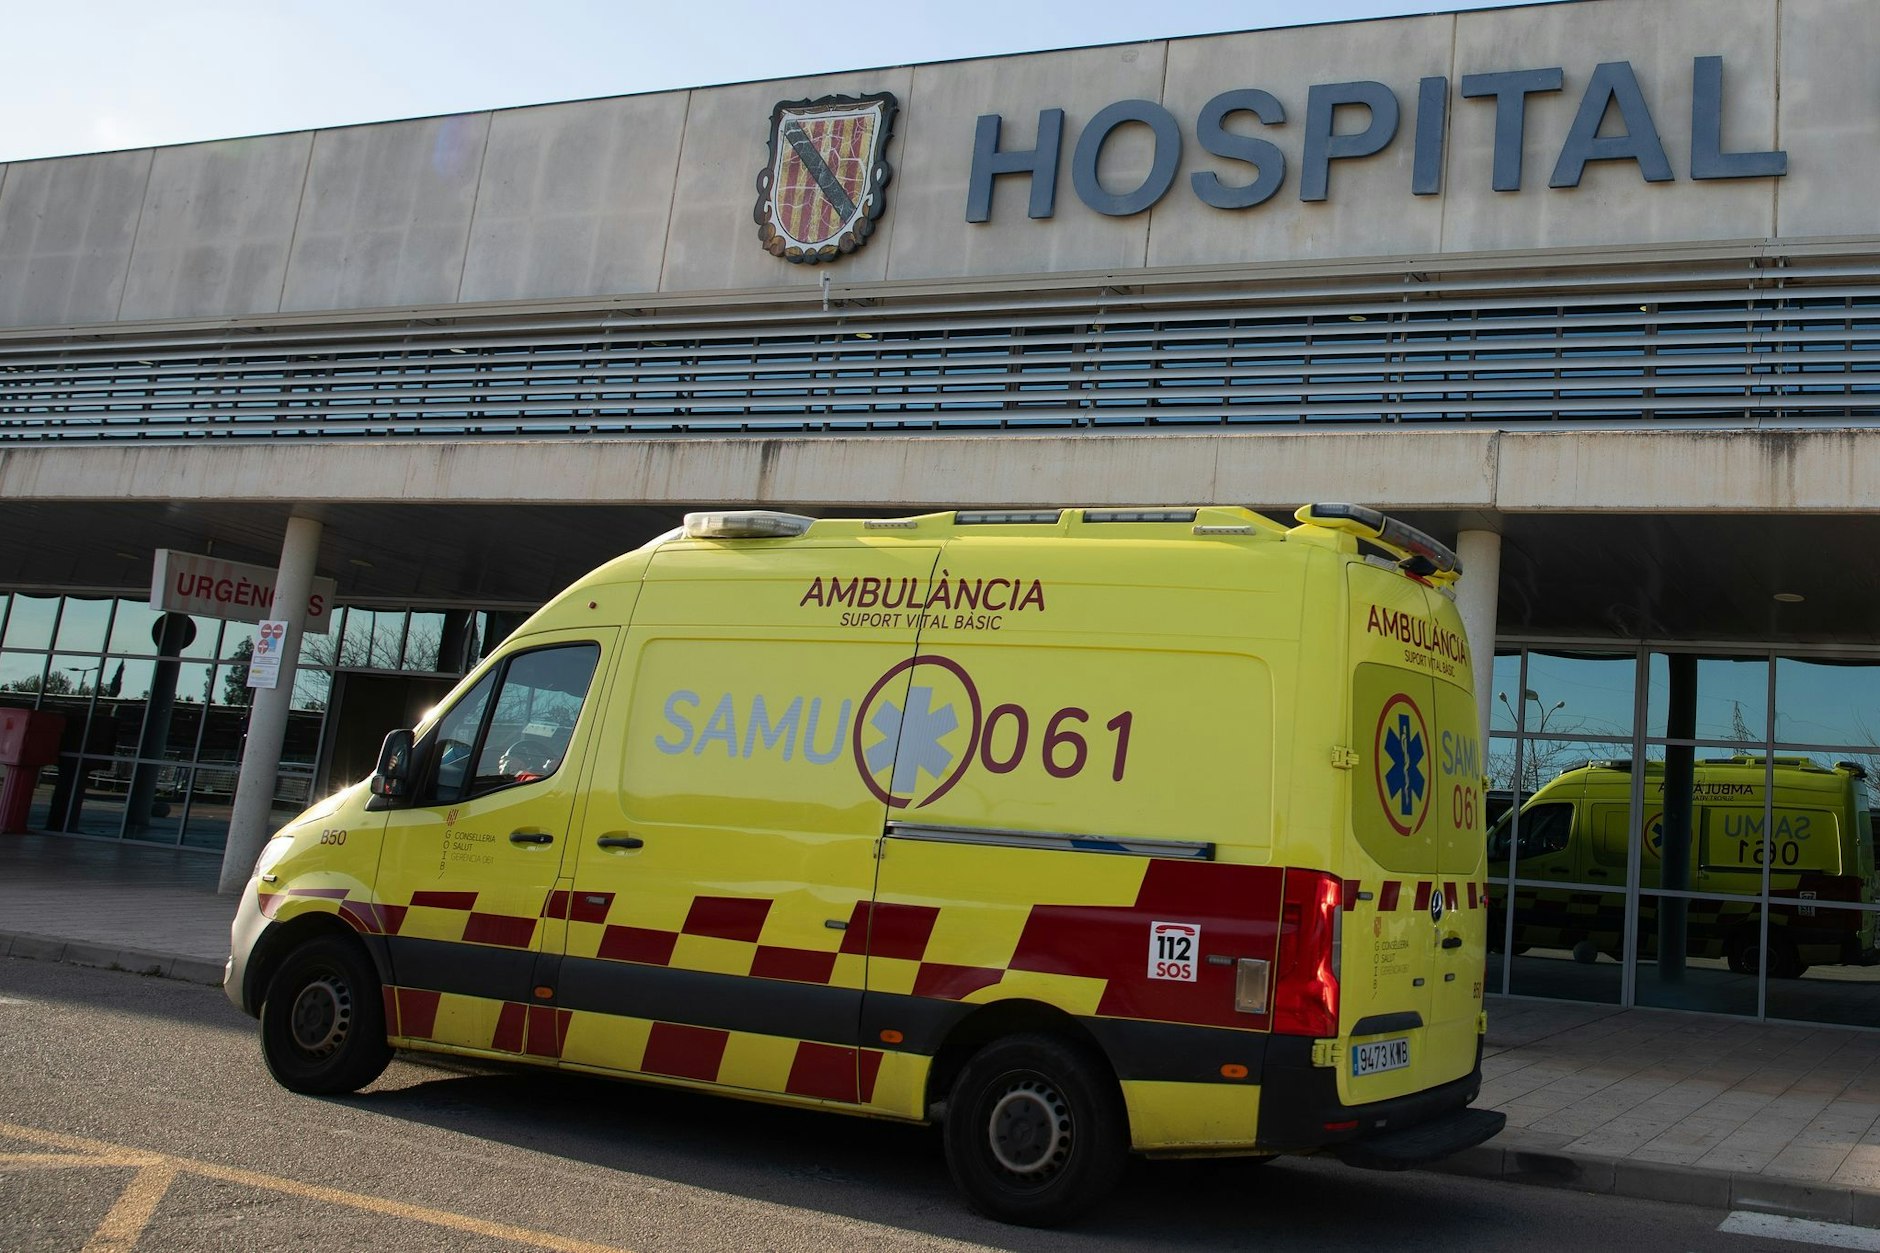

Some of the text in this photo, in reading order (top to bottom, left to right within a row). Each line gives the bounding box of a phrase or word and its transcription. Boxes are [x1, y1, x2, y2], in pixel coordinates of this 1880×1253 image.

[965, 56, 1787, 223] HOSPITAL
[177, 572, 324, 616] URGÈNS
[800, 569, 1045, 612] AMBULÀNCIA
[840, 612, 1003, 630] SUPORT VITAL BÀSIC
[1367, 604, 1467, 667] AMBULÀNCIA
[654, 689, 853, 765] SAMU
[980, 703, 1133, 782] 061
[1453, 784, 1478, 831] 061
[320, 829, 347, 846] B50
[452, 841, 473, 851] SALUT
[454, 831, 496, 844] CONSELLERIA
[1157, 935, 1191, 961] 112
[1156, 962, 1191, 980] SOS
[1360, 1044, 1388, 1071] 9473
